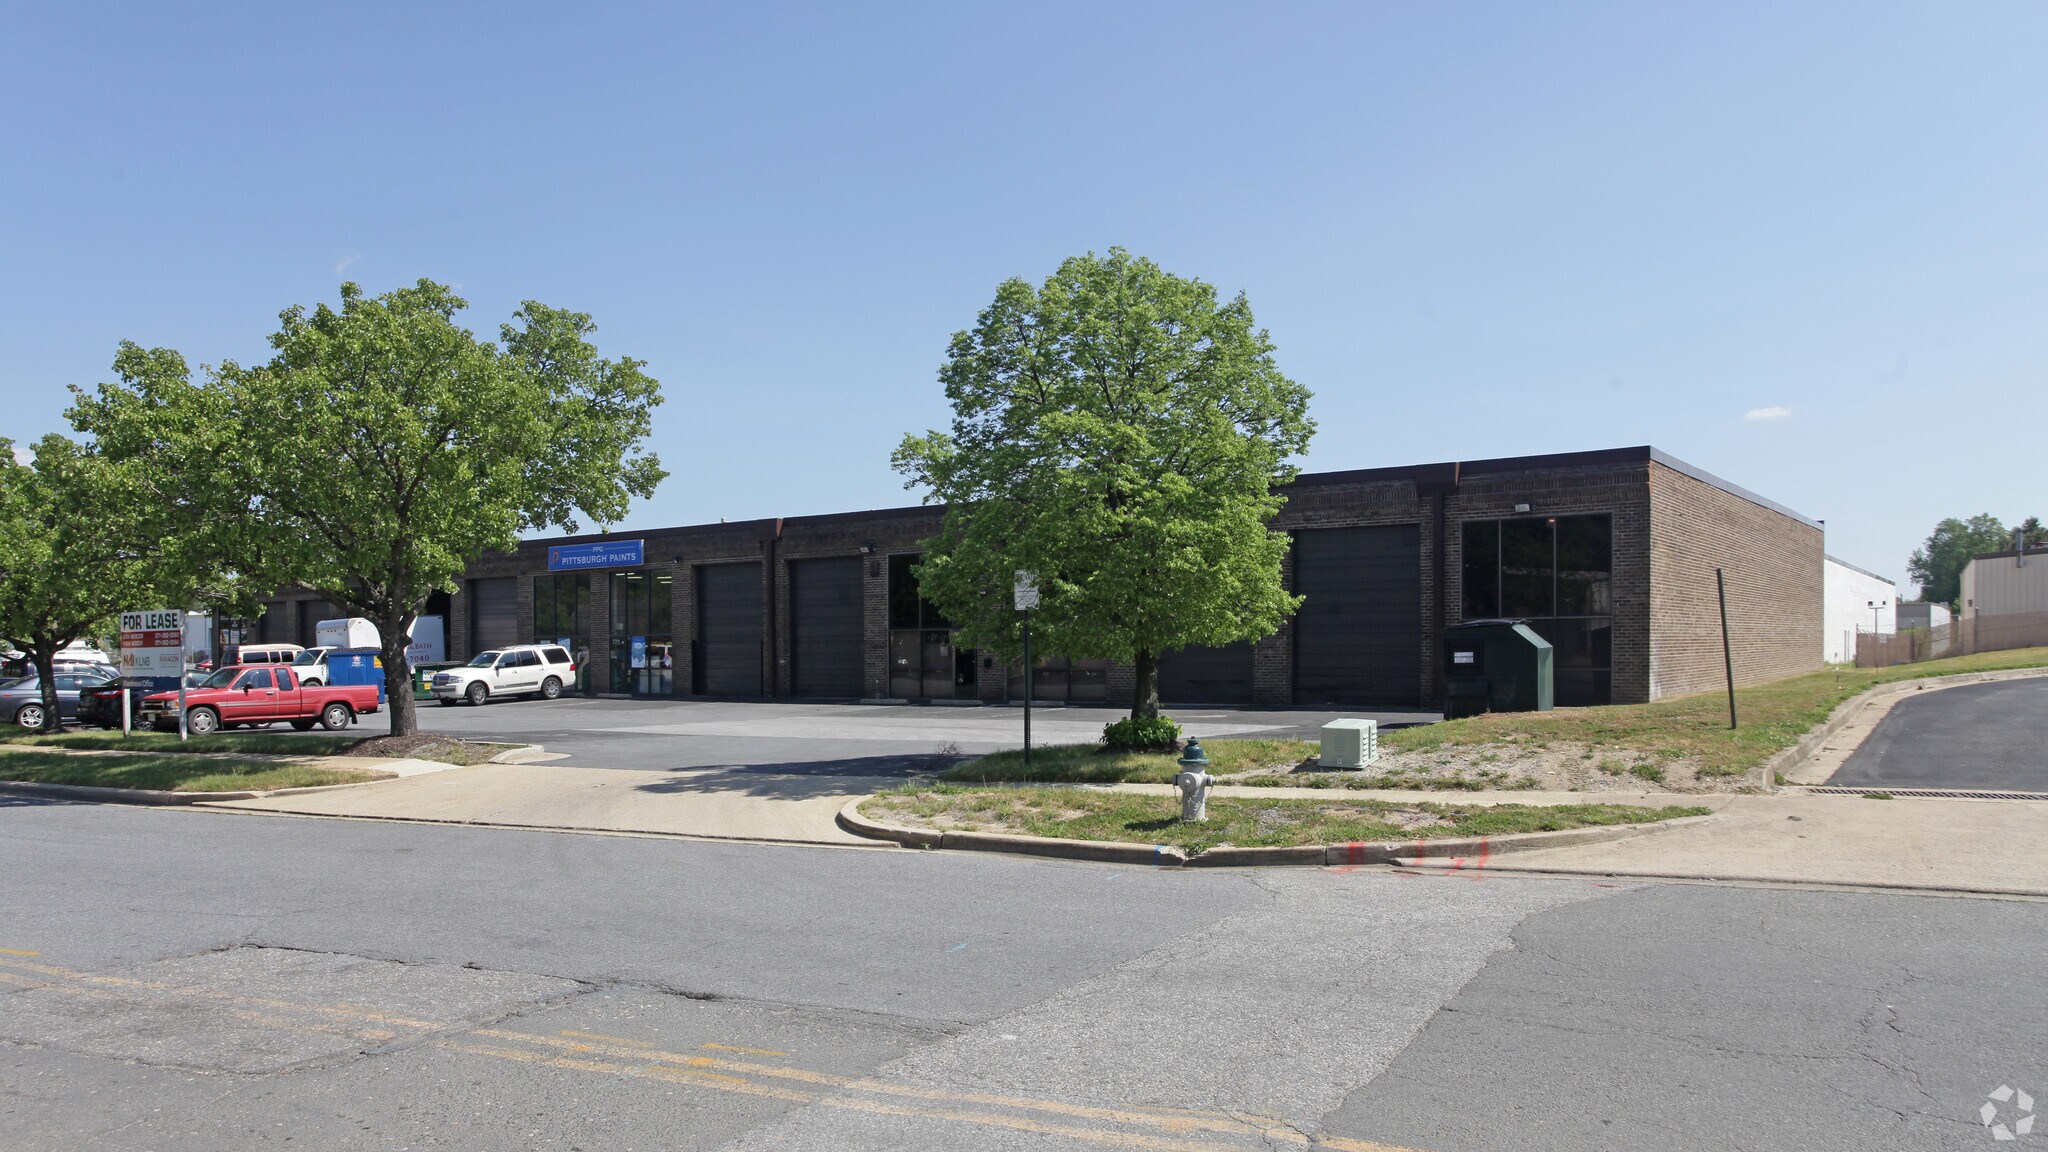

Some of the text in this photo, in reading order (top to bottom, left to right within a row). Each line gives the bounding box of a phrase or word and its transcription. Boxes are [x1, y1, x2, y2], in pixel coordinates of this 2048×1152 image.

[562, 553, 636, 565] PITTSBURGH PAINTS
[123, 613, 178, 630] FOR LEASE
[135, 656, 151, 667] KLNB
